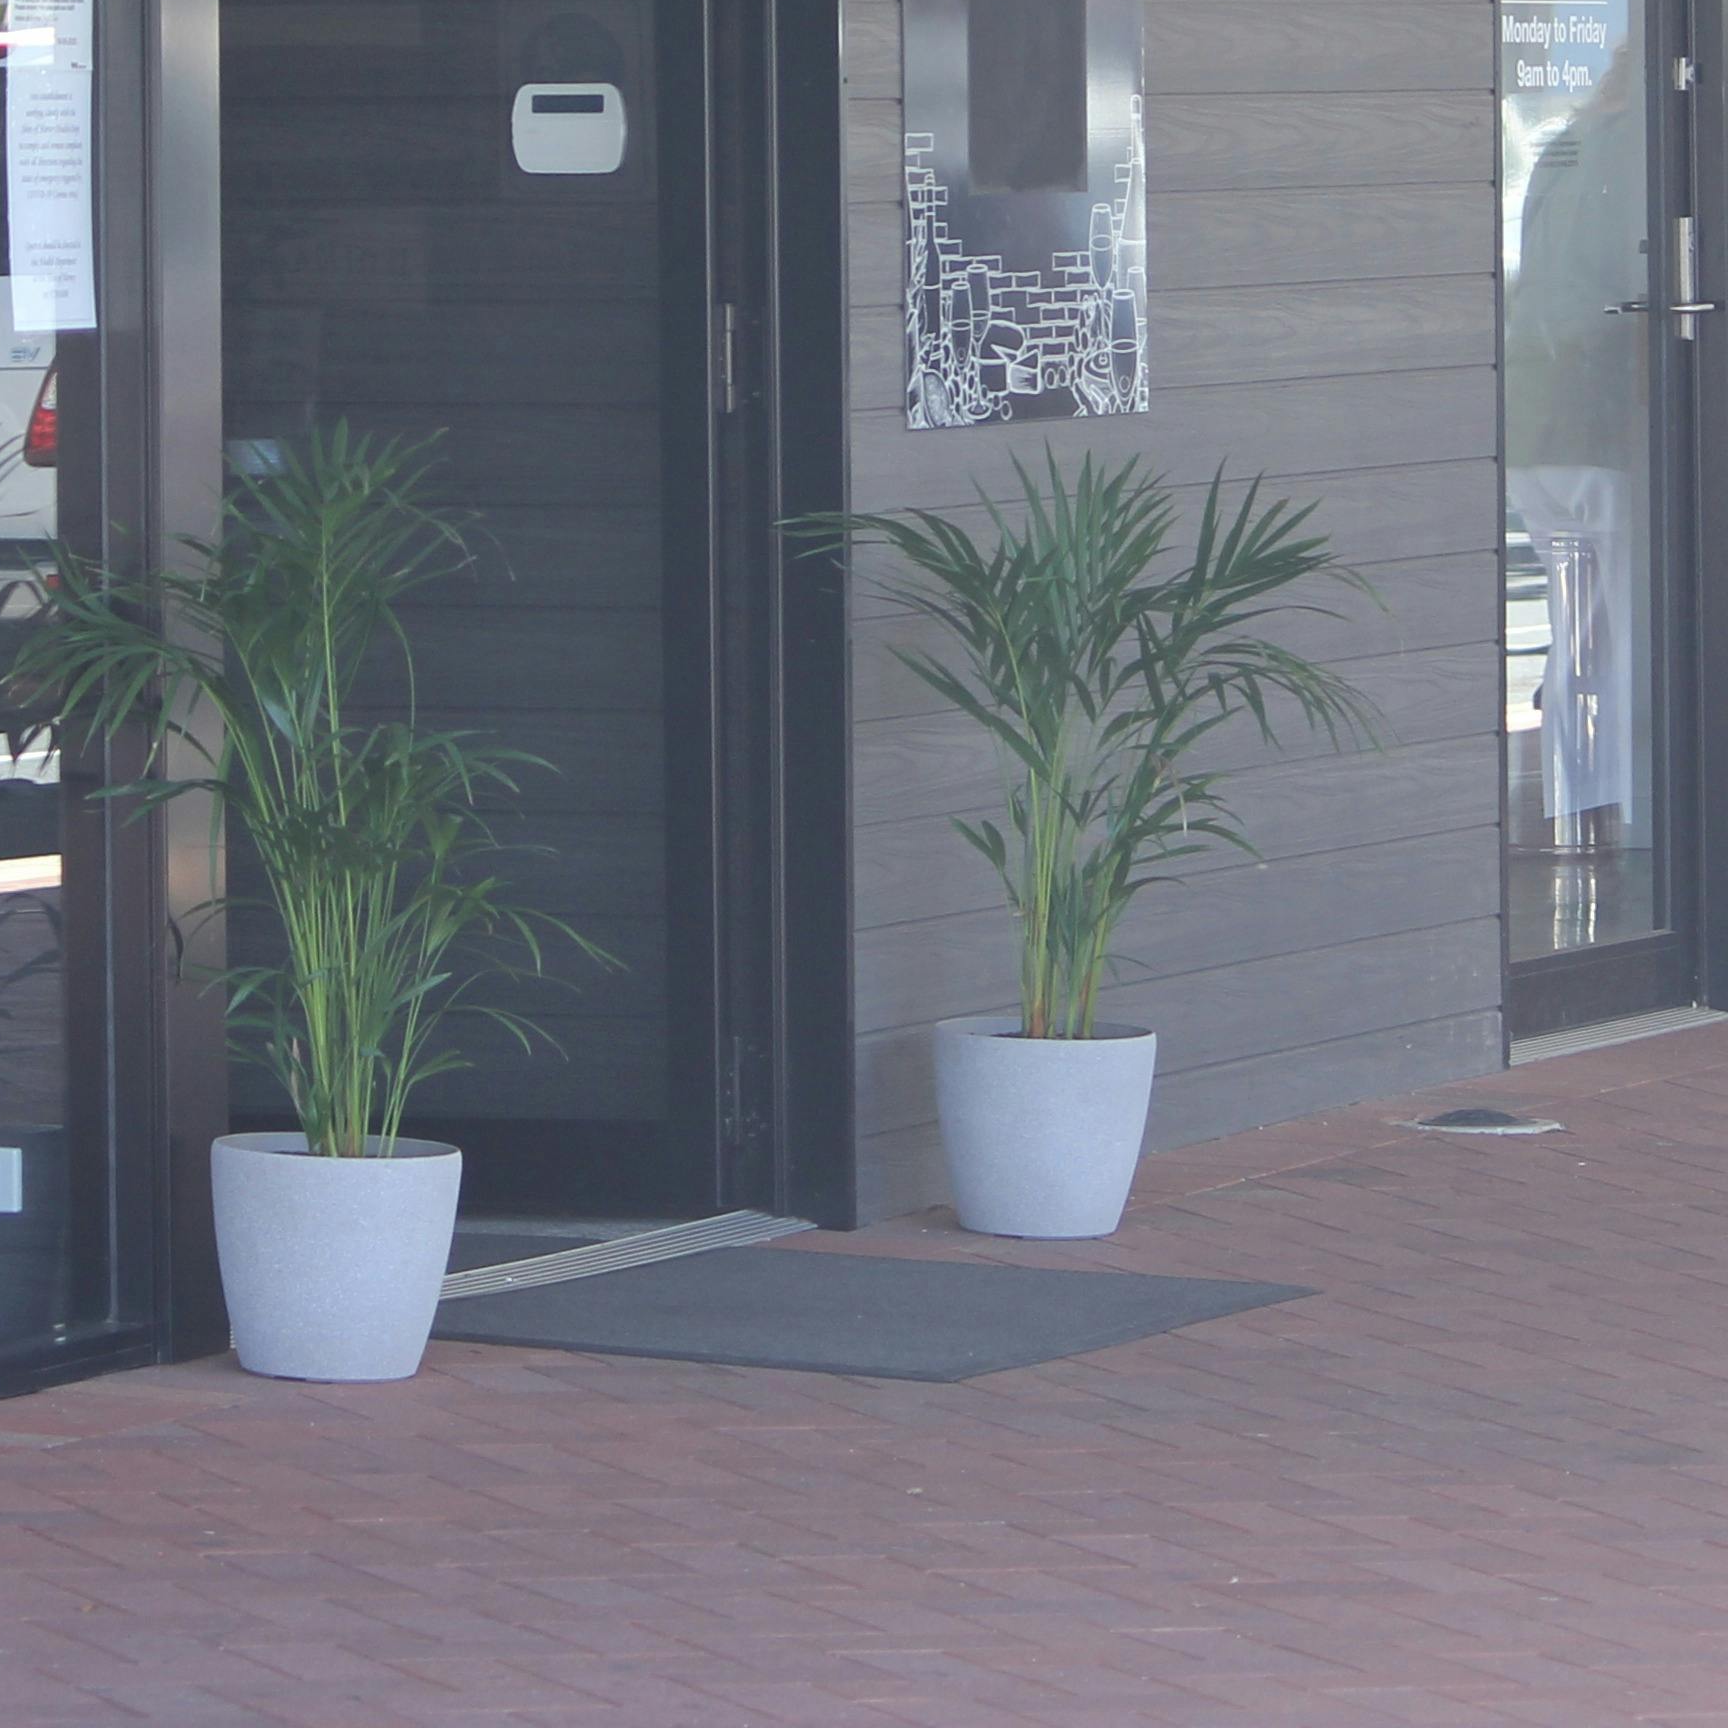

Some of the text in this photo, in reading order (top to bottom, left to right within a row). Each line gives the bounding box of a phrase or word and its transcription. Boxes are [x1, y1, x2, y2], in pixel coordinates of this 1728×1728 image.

[1501, 15, 1607, 49] Monday to Friday
[1517, 59, 1592, 93] 9am to 4pm.
